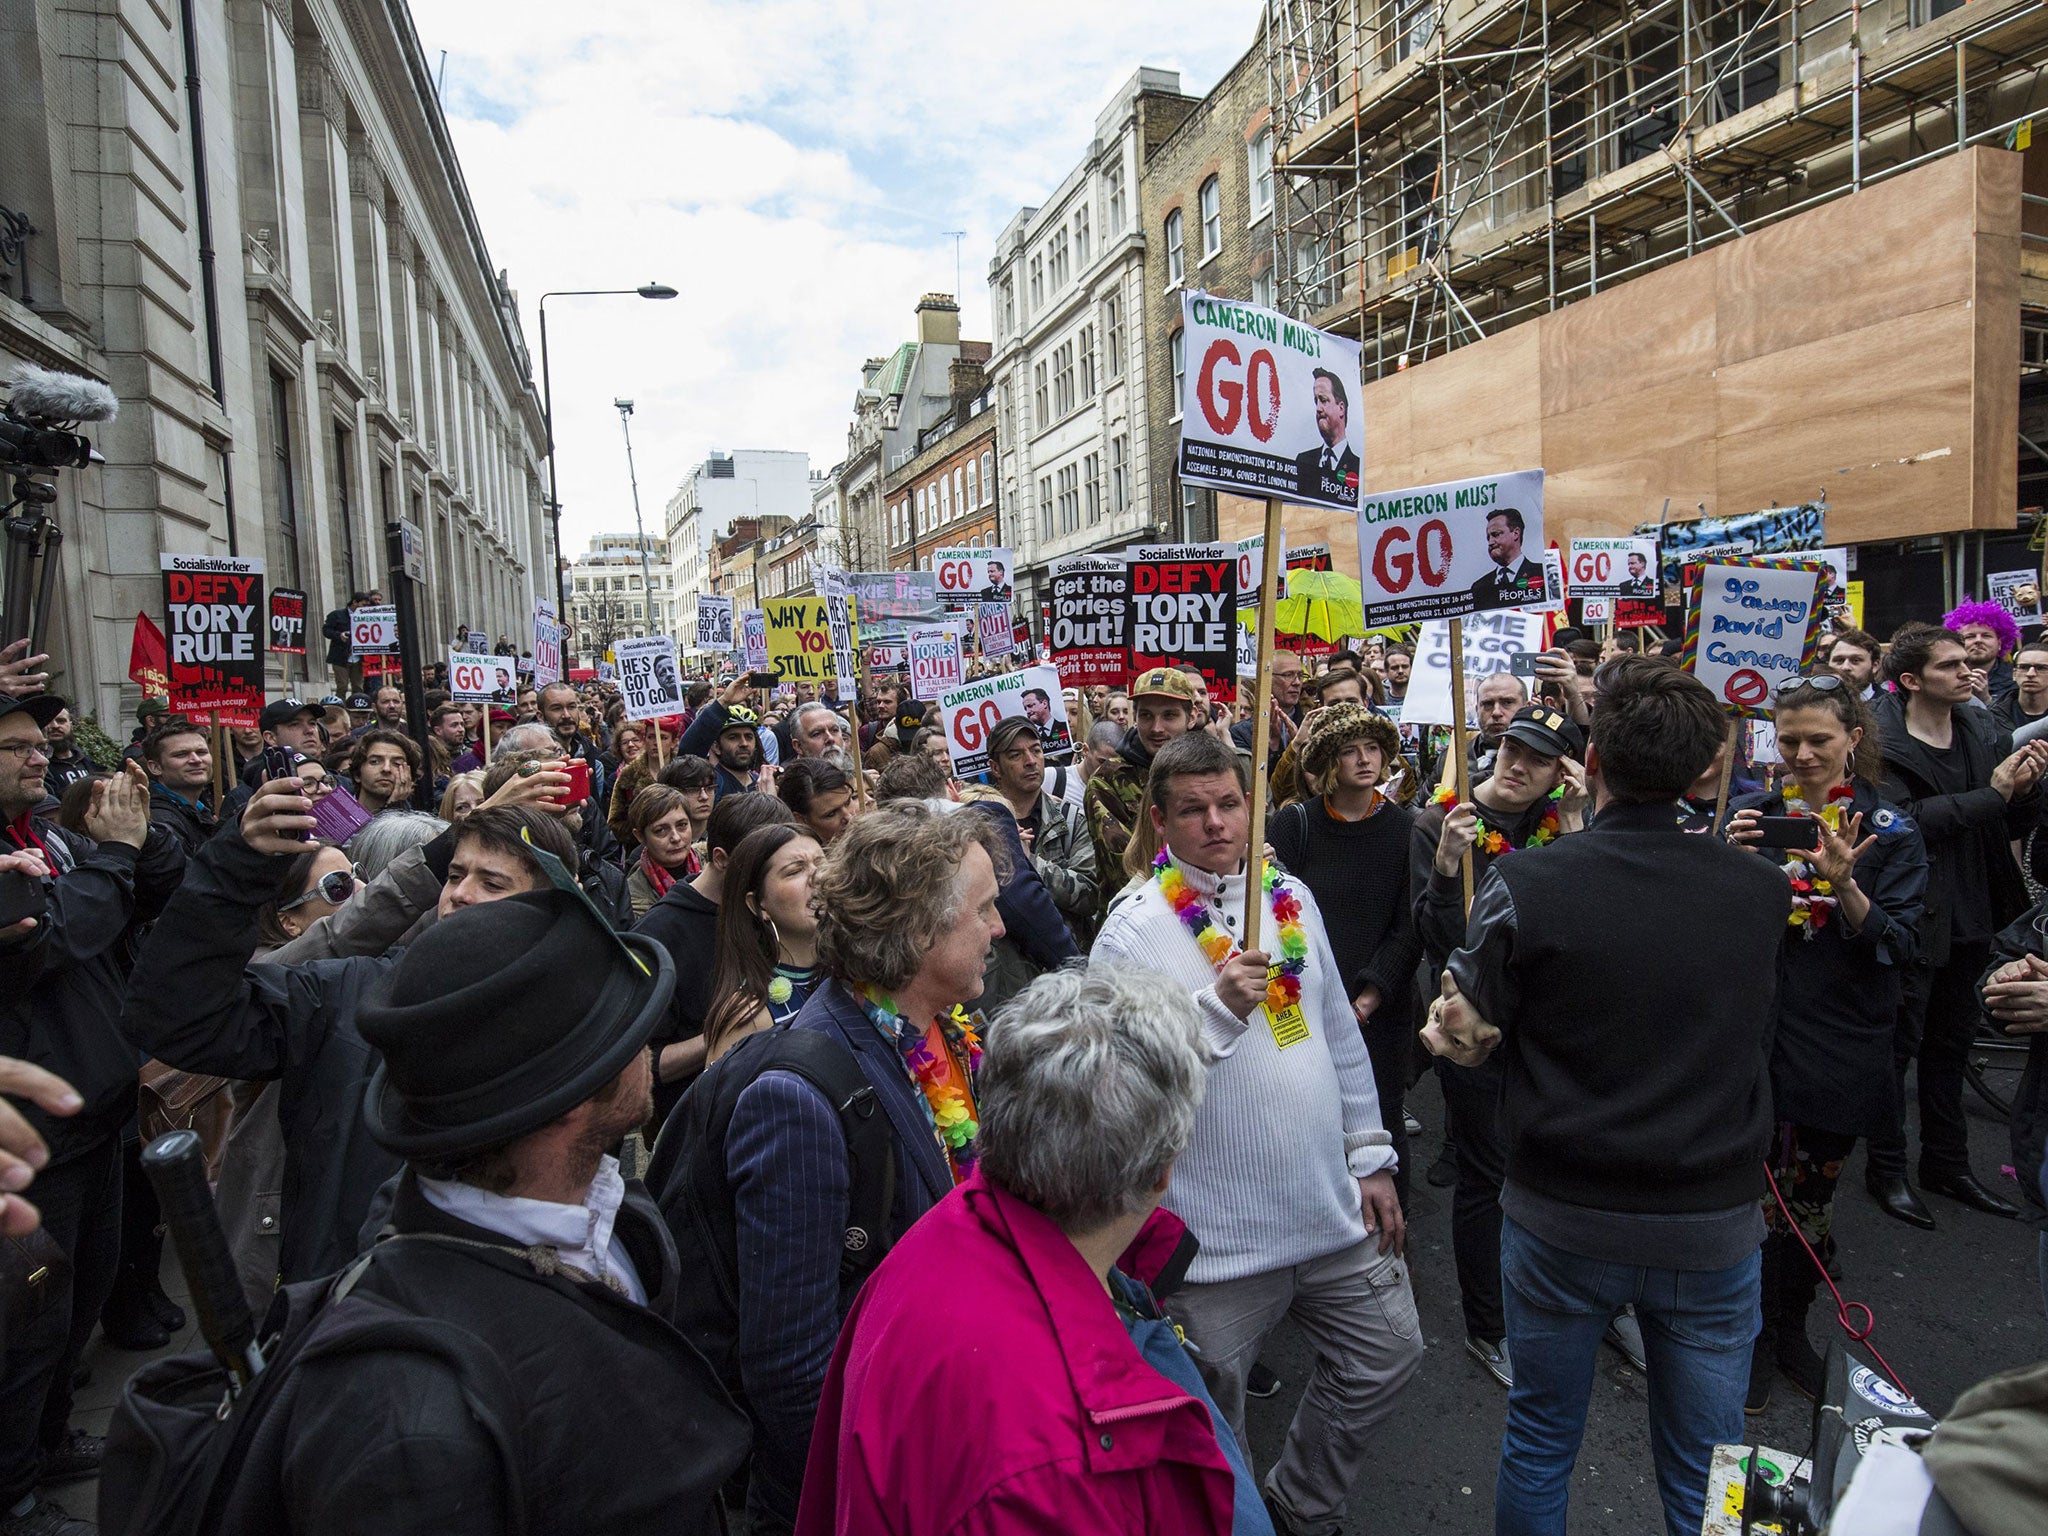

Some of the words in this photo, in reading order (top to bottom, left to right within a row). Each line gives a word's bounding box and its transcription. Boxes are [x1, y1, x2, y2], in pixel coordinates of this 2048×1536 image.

[1193, 299, 1277, 344] CAMERON
[1283, 322, 1321, 358] MUST
[1196, 338, 1281, 444] GO
[1187, 444, 1216, 459] NATIONAL
[1219, 450, 1265, 468] DEMONSTRATION
[1266, 459, 1276, 469] SAT
[1276, 462, 1283, 471] 16
[1284, 464, 1298, 475] APRIL
[1236, 470, 1257, 481] GOWER
[1267, 475, 1287, 489] LONDON
[1365, 491, 1448, 523] CAMERON
[1455, 483, 1498, 510] MUST
[937, 551, 971, 560] CAMERON
[973, 550, 992, 559] MUST
[1372, 519, 1453, 594] GO
[1573, 541, 1610, 551] CAMERON
[1613, 541, 1633, 550] MUST
[939, 561, 973, 590] GO
[1134, 562, 1229, 594] DEFY
[1574, 552, 1611, 583] GO
[169, 574, 255, 604] DEFY
[1054, 576, 1086, 597] Get
[1090, 575, 1126, 593] the
[1722, 577, 1759, 603] go
[766, 604, 807, 629] WHY
[1054, 593, 1126, 619] Tories
[1131, 593, 1228, 623] TORY
[1369, 606, 1395, 614] NATIONAL
[1396, 598, 1440, 612] DEMONSTRATION
[1443, 606, 1463, 615] LONDON
[1586, 604, 1603, 617] GO
[1741, 595, 1807, 624] away
[169, 603, 255, 633] TORY
[698, 618, 715, 630] GOT
[980, 615, 1008, 637] OUT!
[1712, 614, 1783, 639] David
[355, 623, 382, 644] GO
[698, 630, 710, 642] TO
[712, 631, 723, 643] GO
[1053, 615, 1125, 649] Out!
[1134, 623, 1227, 653] RULE
[172, 633, 254, 663] RULE
[870, 648, 892, 665] GO
[913, 641, 956, 659] TORIES
[1069, 653, 1078, 661] up
[1080, 651, 1093, 660] the
[1095, 652, 1122, 660] strikes
[1479, 637, 1525, 655] GO
[452, 655, 482, 664] CAMERON
[519, 661, 530, 670] GO
[621, 656, 651, 675] HE'S
[773, 655, 818, 677] STILL
[916, 656, 958, 680] OUT!
[1084, 662, 1096, 672] to
[1100, 662, 1122, 672] win
[1706, 642, 1800, 673] Cameron
[455, 665, 485, 691] GO
[625, 673, 650, 691] GOT
[627, 691, 645, 707] TO
[649, 688, 666, 705] GO
[943, 683, 994, 708] CAMERON
[996, 673, 1026, 693] MUST
[176, 701, 200, 710] Strike,
[222, 698, 248, 707] occupy
[1275, 1008, 1293, 1022] AREA
